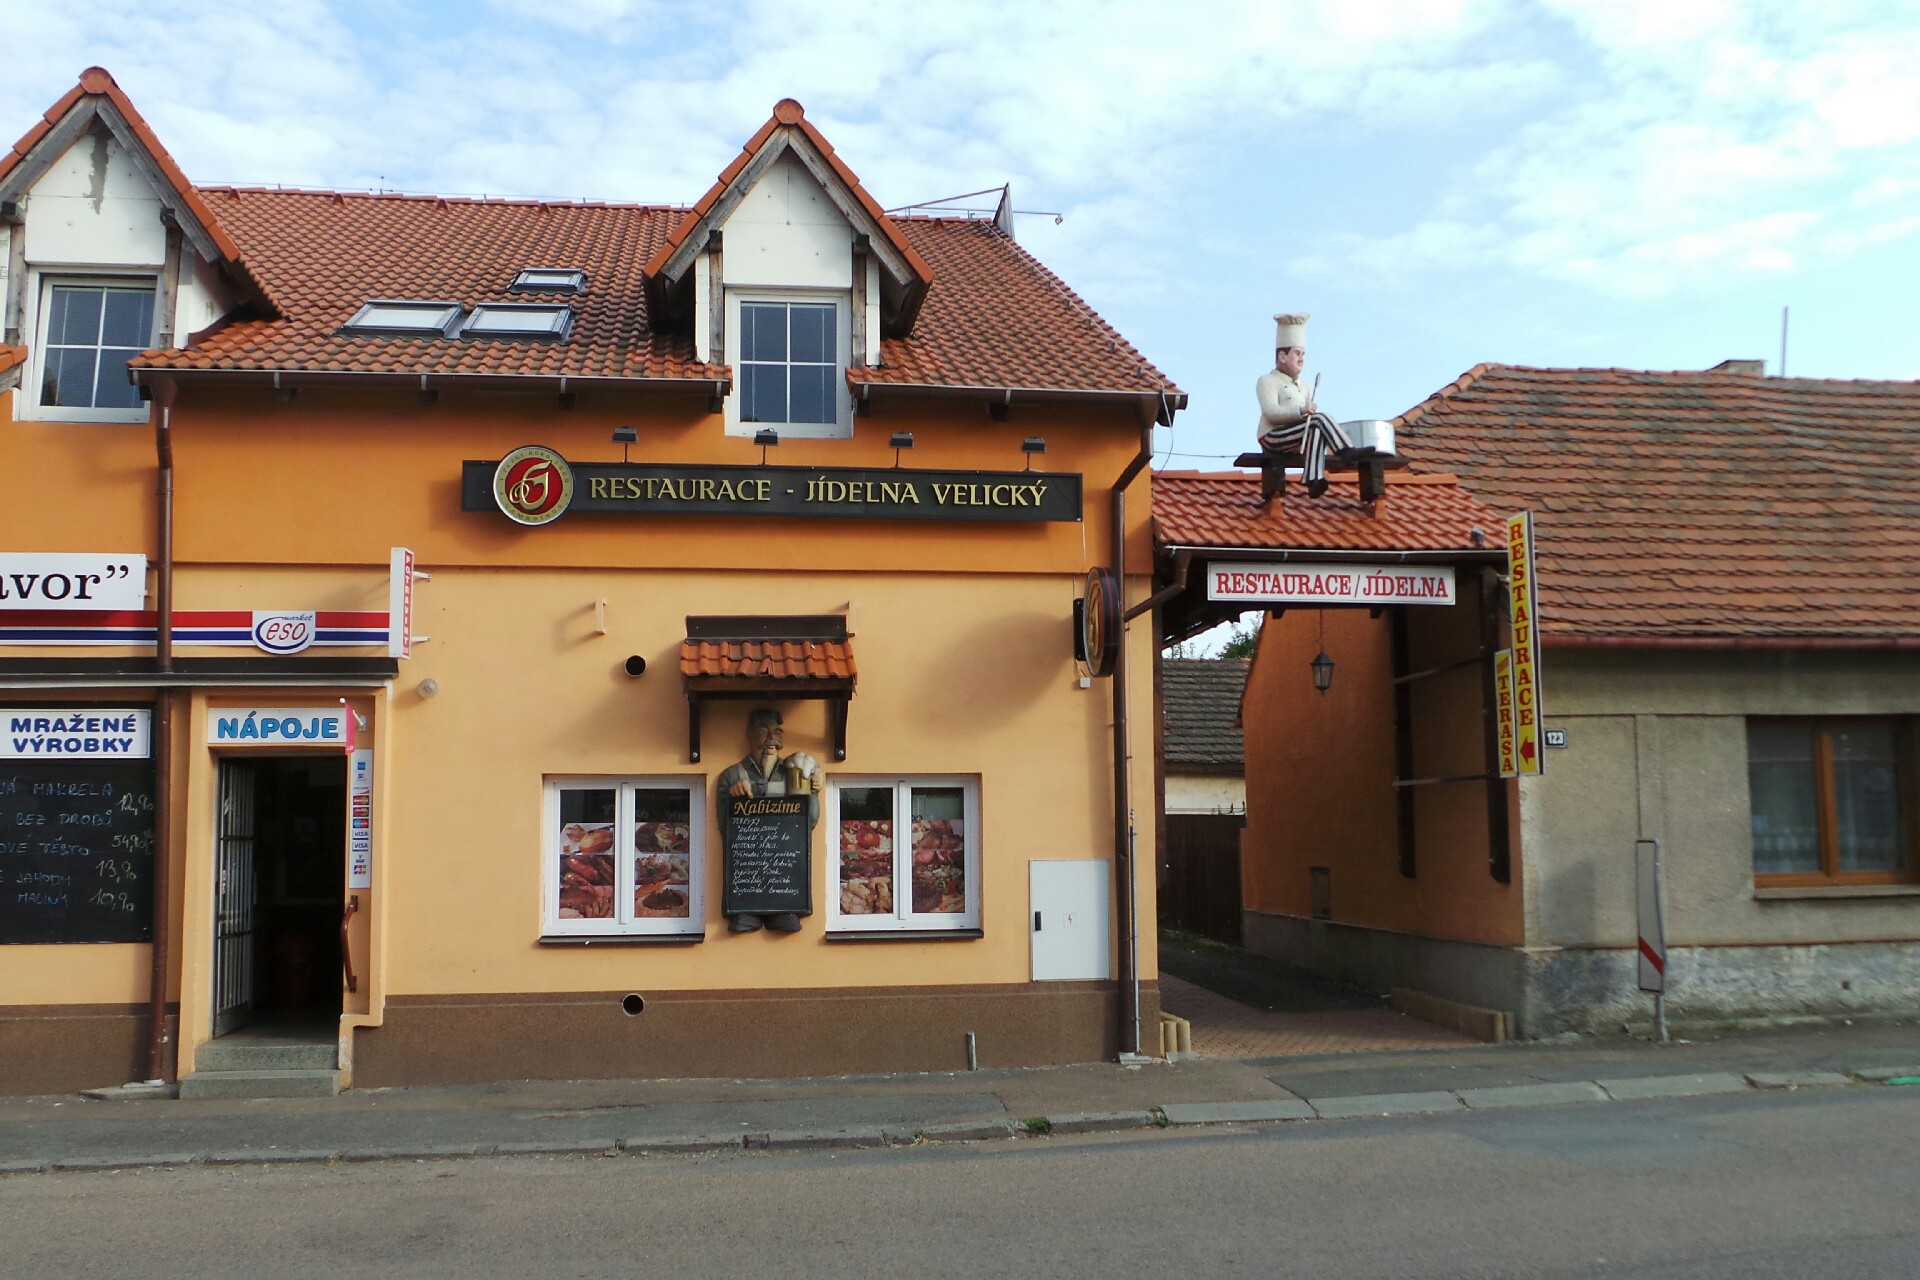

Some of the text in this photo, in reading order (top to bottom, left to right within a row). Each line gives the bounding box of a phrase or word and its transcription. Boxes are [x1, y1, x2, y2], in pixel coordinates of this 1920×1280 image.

[589, 477, 771, 501] RESTAURACE
[805, 475, 920, 504] JÍDELNA
[932, 480, 1048, 506] VELICKÝ
[403, 555, 411, 645] POTRAVINY
[281, 613, 313, 621] market
[1509, 523, 1533, 726] RESTAURACE
[266, 622, 306, 641] eso
[10, 713, 137, 733] MRAŽENÉ
[217, 711, 339, 739] NÁPOJE
[1498, 675, 1514, 772] TERASA
[12, 734, 133, 753] VÝROBKY
[1547, 732, 1564, 744] 123
[33, 782, 114, 796] MAKRELA
[16, 812, 46, 826] BEZ
[16, 872, 71, 888] JAHODY
